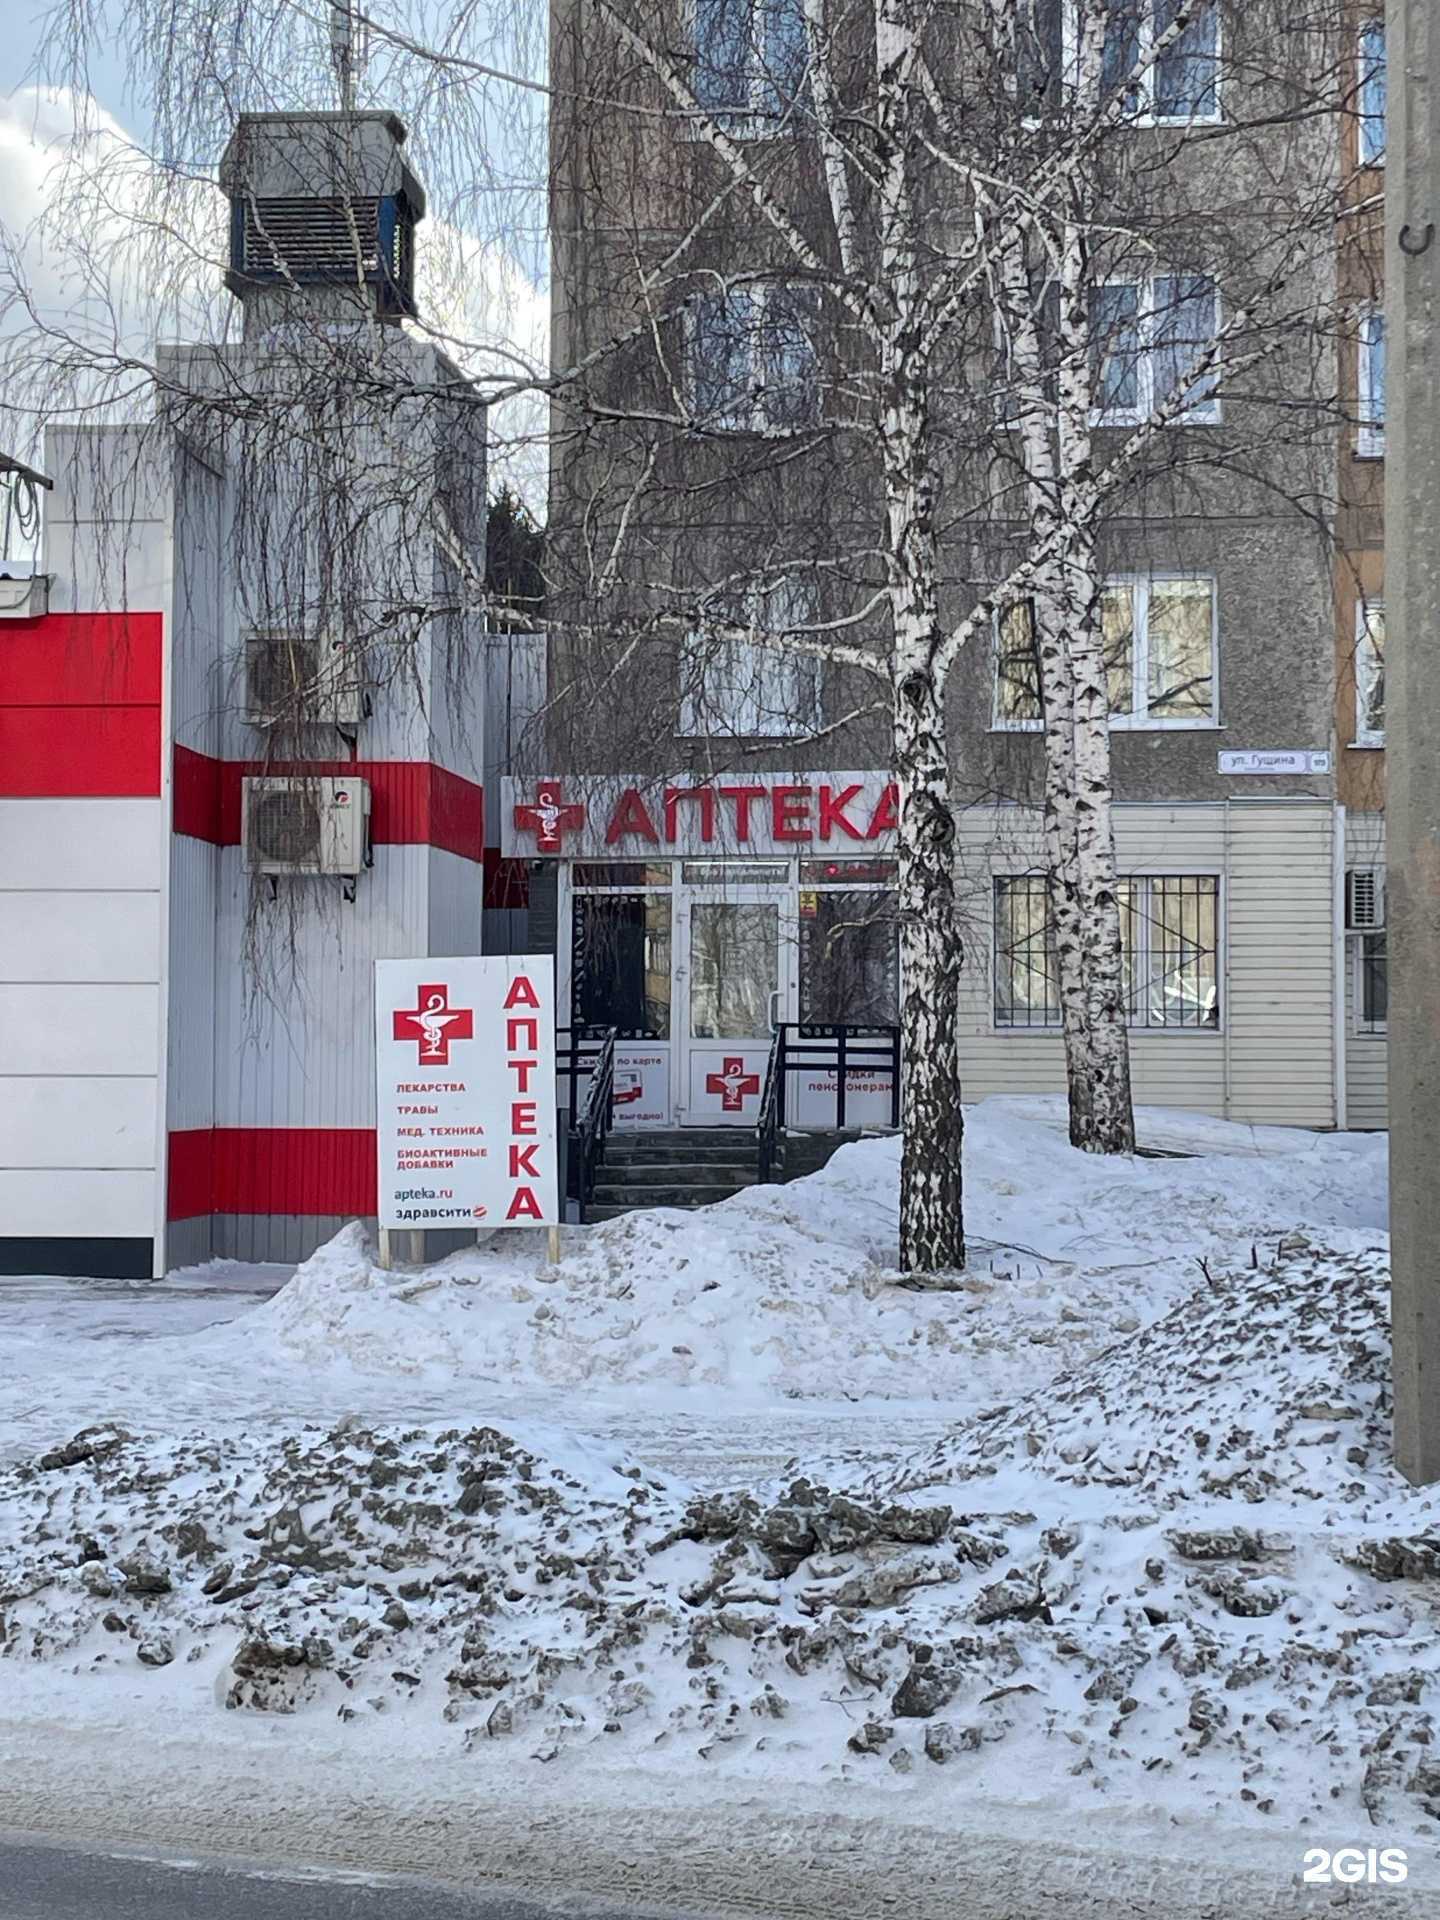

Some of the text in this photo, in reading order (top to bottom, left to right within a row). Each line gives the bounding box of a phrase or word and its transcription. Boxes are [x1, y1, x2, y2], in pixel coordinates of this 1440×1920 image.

[1231, 754, 1295, 768] ул. Гущина
[607, 784, 899, 843] АПТЕКА
[632, 1058, 662, 1067] карте
[396, 1083, 466, 1093] ЛЕКАРСТВА
[809, 1083, 895, 1093] пенсонерам
[503, 976, 542, 1220] АПТЕКА
[397, 1105, 439, 1115] ТРАВЫ
[397, 1126, 484, 1138] МЕД. ТЕХНИКА
[397, 1148, 488, 1159] БИОАКТИВНЫЕ
[396, 1160, 454, 1171] ДОБАВКИ
[394, 1187, 454, 1202] apteka.ru
[395, 1207, 471, 1221] здравсити
